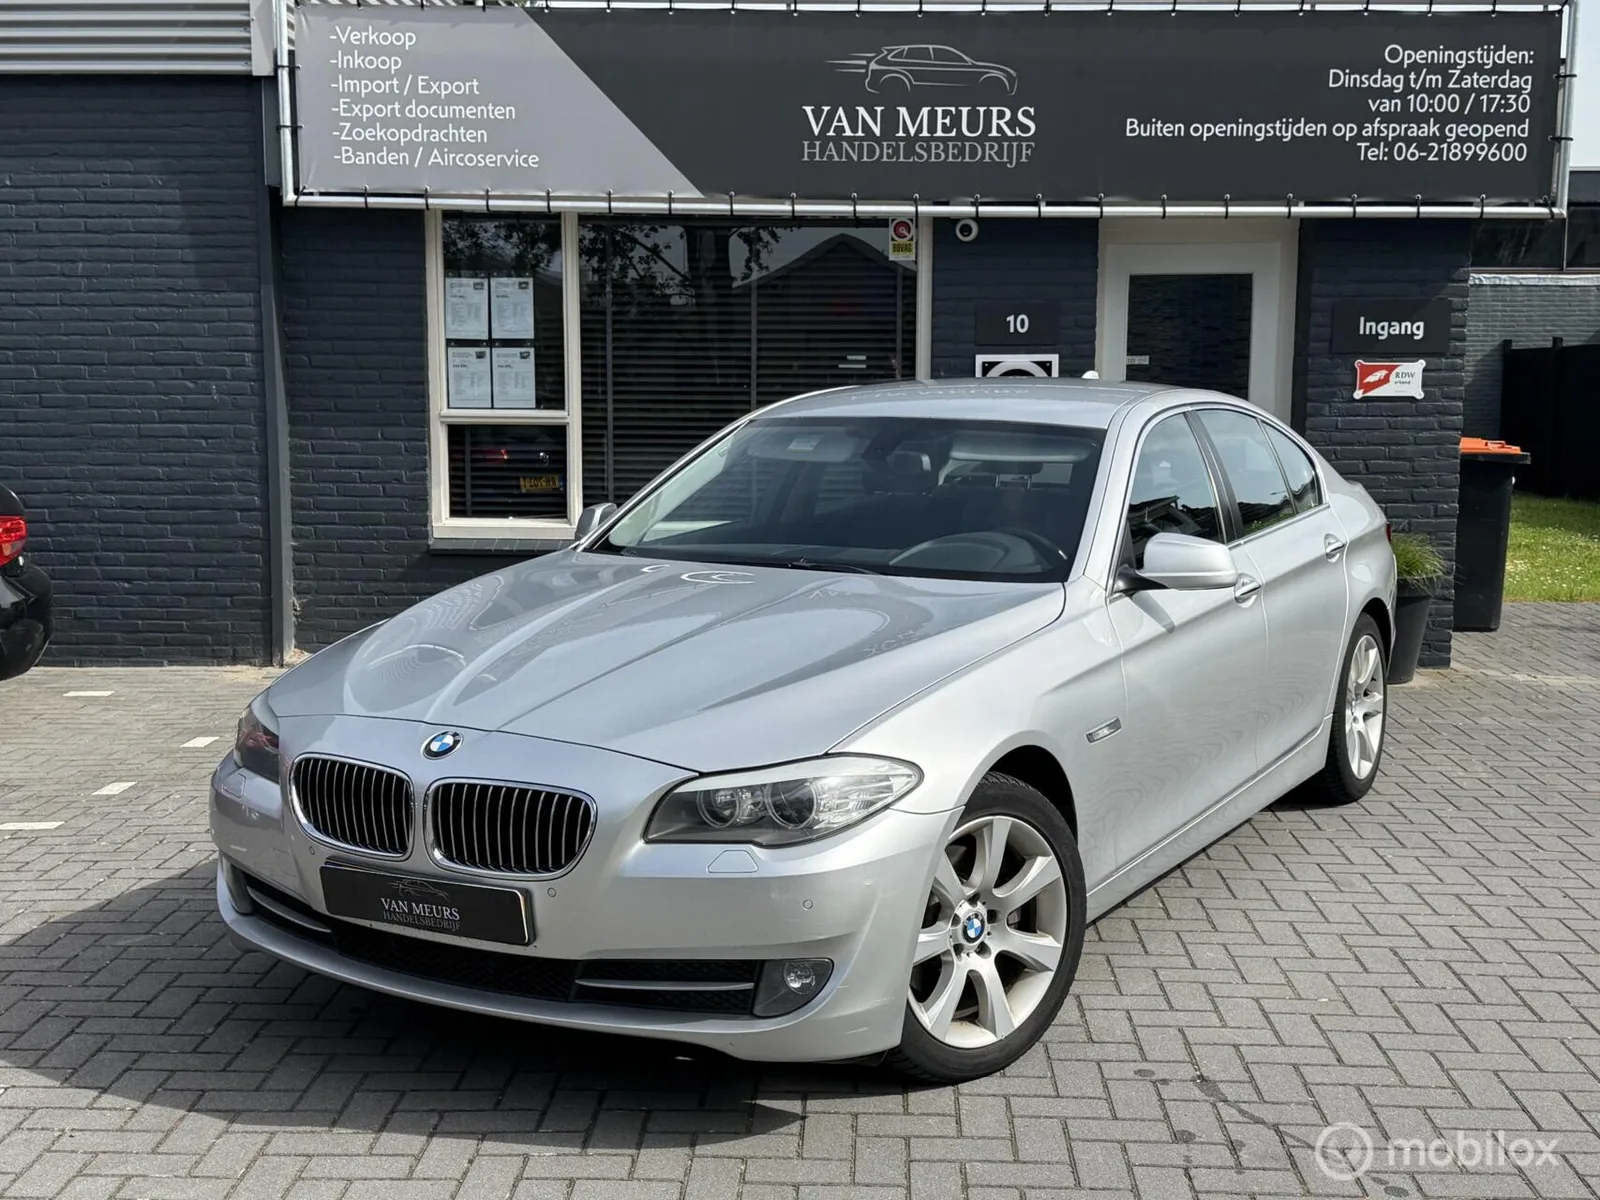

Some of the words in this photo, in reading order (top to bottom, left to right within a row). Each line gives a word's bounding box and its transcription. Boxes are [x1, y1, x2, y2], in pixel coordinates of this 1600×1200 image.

[329, 25, 417, 50] -Verkoop
[329, 50, 402, 74] -Inkoop
[1384, 44, 1535, 69] Openingstijden:
[330, 74, 400, 98] -Import
[403, 74, 413, 96] /
[417, 75, 480, 99] Export
[1328, 68, 1404, 93] Dinsdag
[1408, 68, 1442, 90] t/m
[1447, 69, 1533, 94] Zaterdag
[331, 98, 401, 122] -Export
[404, 98, 516, 120] documenten
[1367, 98, 1401, 113] van
[1406, 93, 1460, 113] 10:00
[1464, 92, 1476, 115] /
[1479, 94, 1531, 113] 17:30
[801, 105, 885, 137] VAN
[895, 106, 1037, 137] MEURS
[1126, 118, 1185, 138] Buiten
[1189, 117, 1327, 142] openingstijden
[1332, 123, 1358, 142] op
[1361, 117, 1440, 142] afspraak
[1444, 118, 1529, 143] geopend
[332, 122, 488, 146] -Zoekopdrachten
[333, 146, 409, 165] -Banden
[414, 146, 423, 168] /
[427, 147, 540, 168] Aircoservice
[801, 140, 1036, 169] HANDELSBEDRIJF
[1356, 141, 1390, 161] Tel:
[1393, 141, 1528, 162] 06-21899600
[1005, 314, 1030, 334] 10
[1358, 316, 1426, 340] Ingang
[1395, 371, 1416, 379] RDW
[380, 898, 409, 914] VAN
[411, 902, 461, 921] MEURS
[382, 910, 461, 932] HANDELSBEDRIJF
